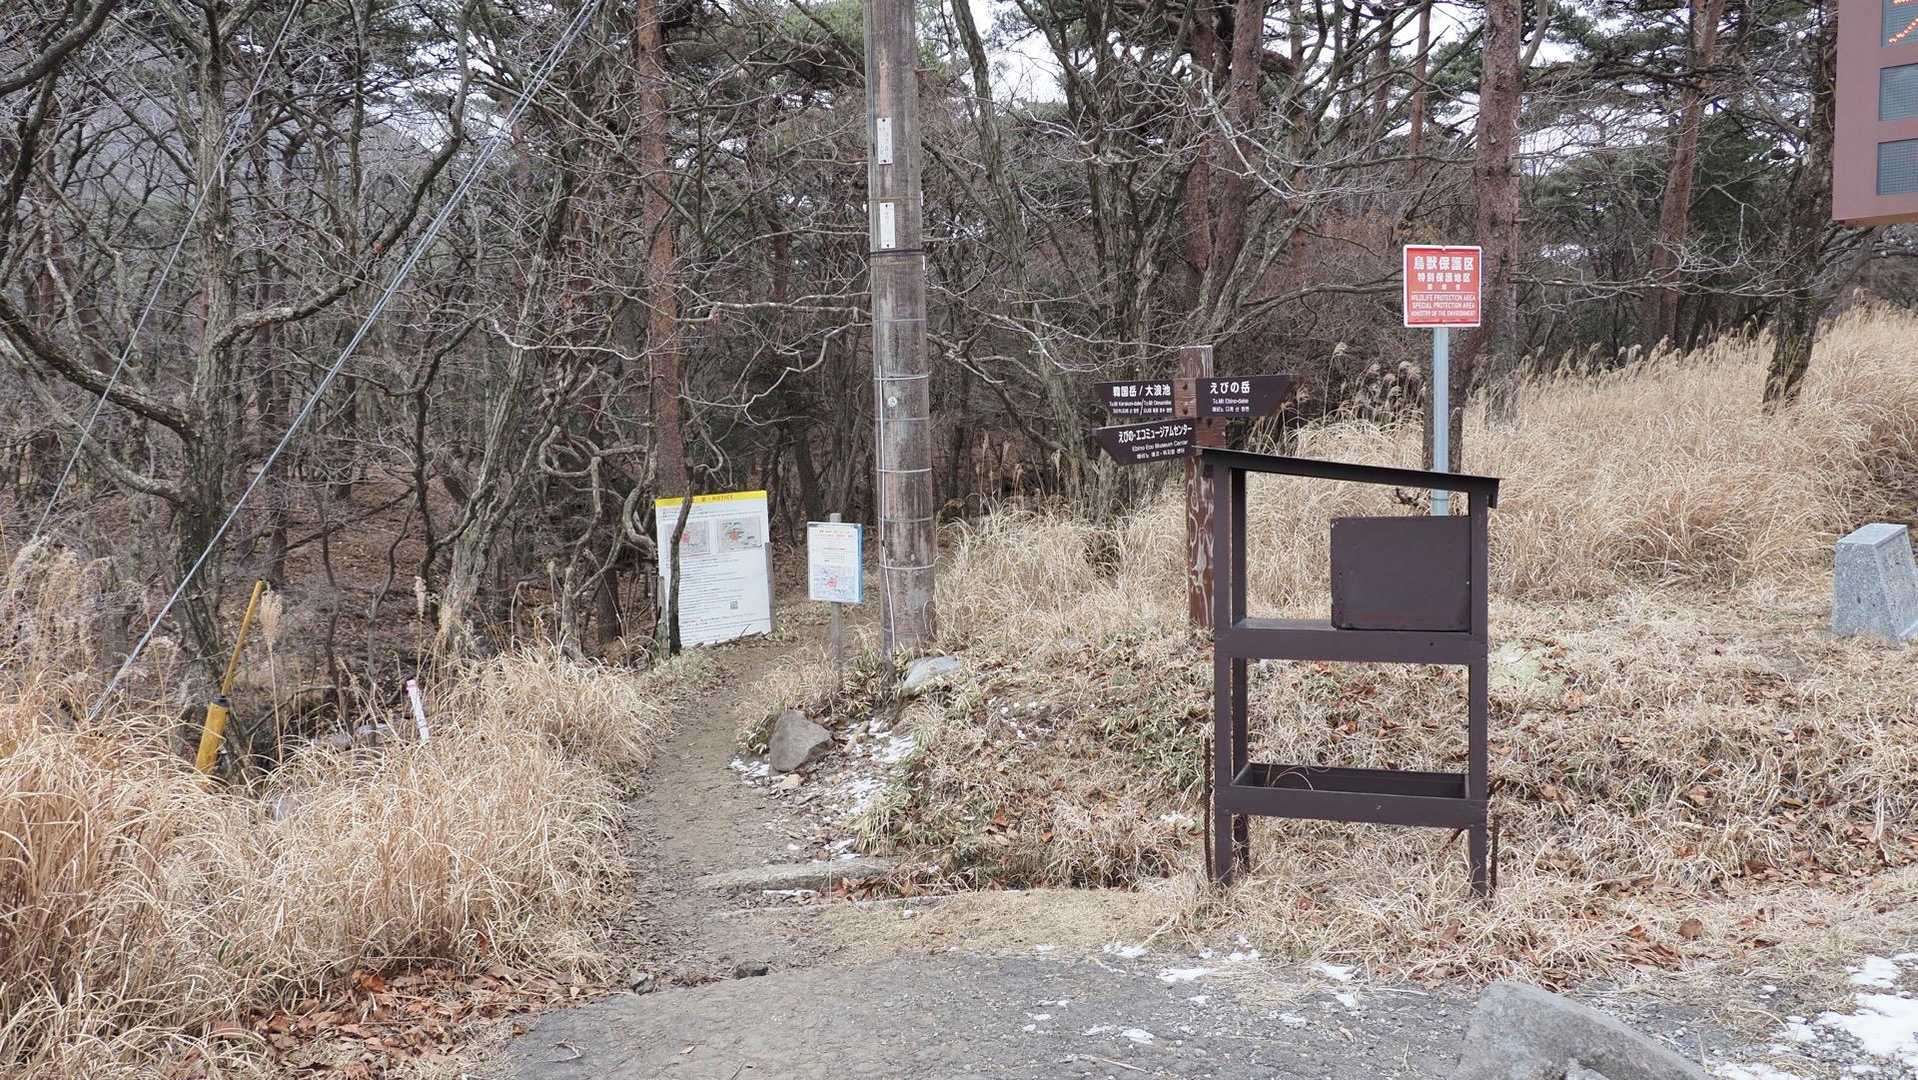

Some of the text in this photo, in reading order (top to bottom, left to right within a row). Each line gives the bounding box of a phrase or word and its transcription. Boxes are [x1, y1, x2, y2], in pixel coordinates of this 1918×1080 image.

[1145, 384, 1171, 396] 大浪池
[1209, 380, 1250, 394] えびの岳
